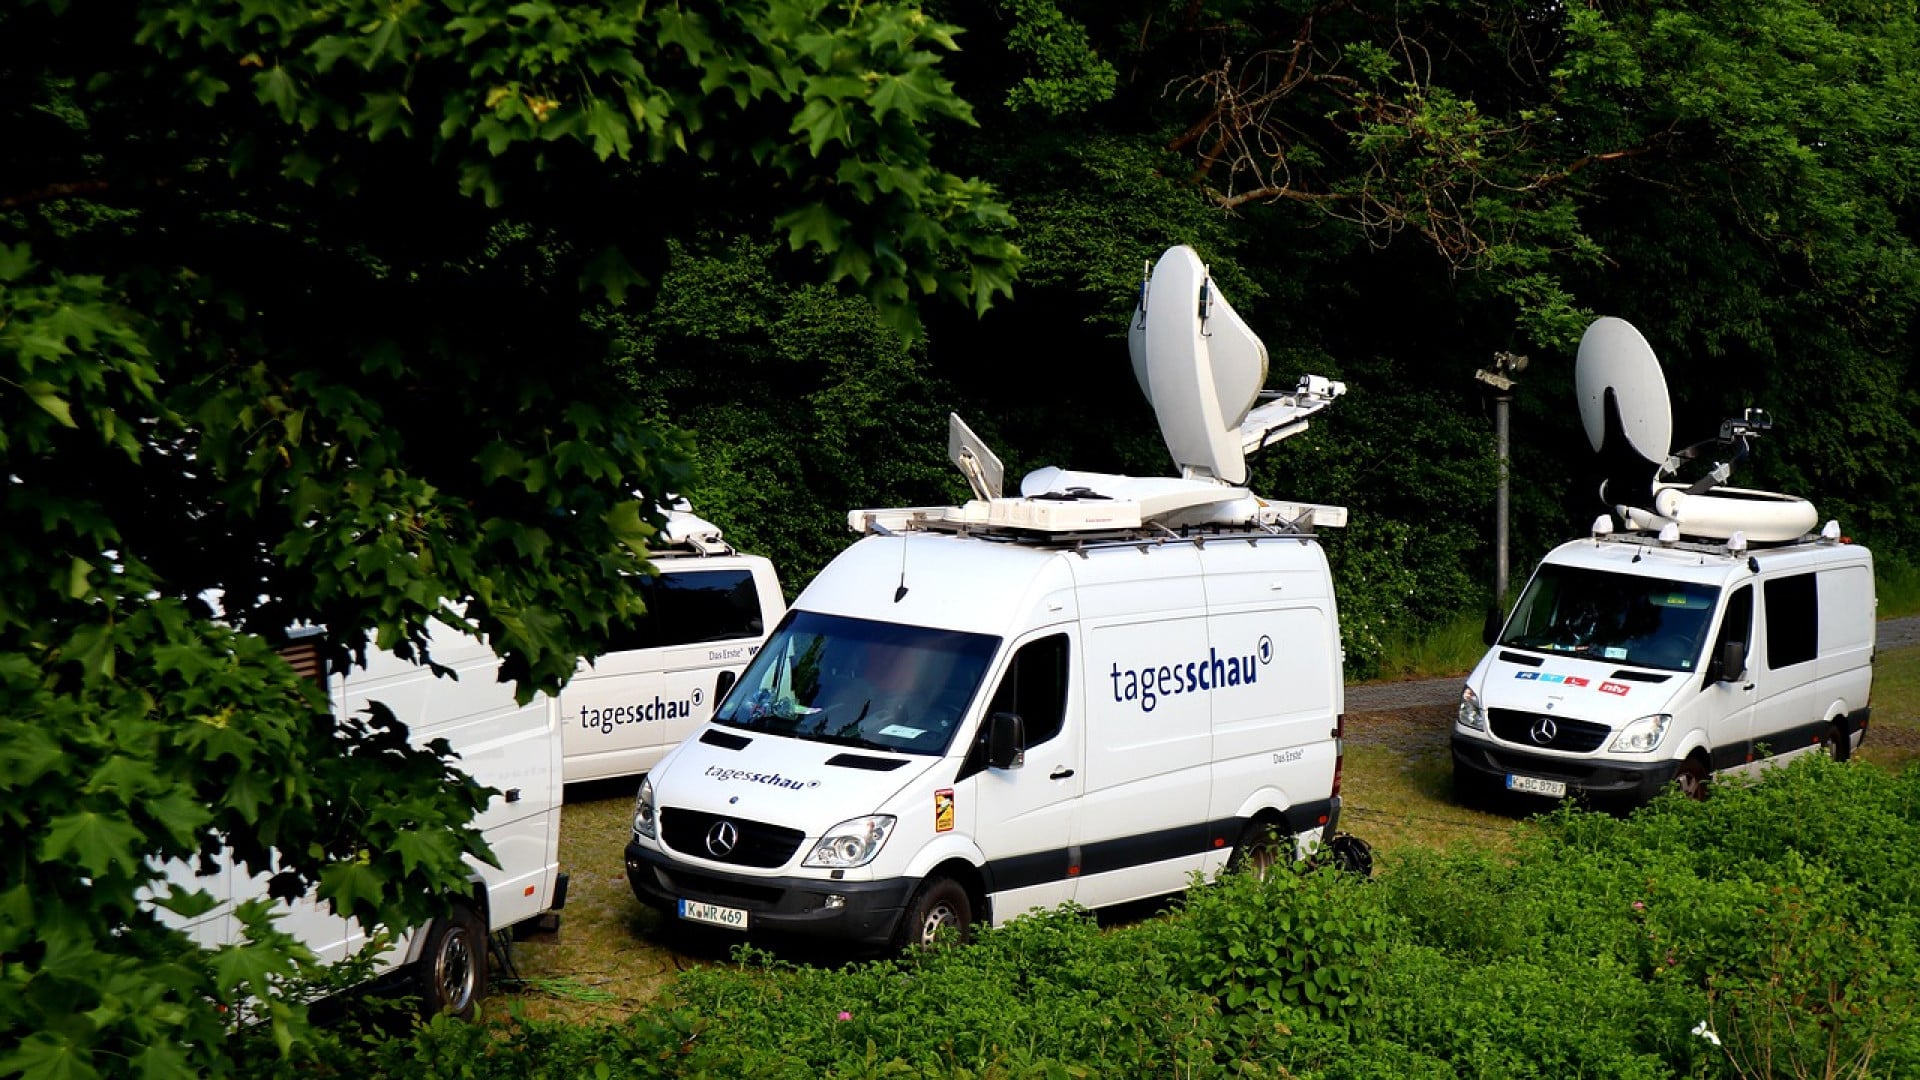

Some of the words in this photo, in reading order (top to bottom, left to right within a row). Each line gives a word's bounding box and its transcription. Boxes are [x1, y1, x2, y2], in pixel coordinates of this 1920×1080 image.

[709, 650, 721, 661] Das
[1110, 647, 1257, 713] tagesschau
[580, 696, 690, 734] tagesschau
[1273, 753, 1285, 764] Das
[704, 763, 804, 790] tagesschau
[688, 902, 696, 917] K
[702, 905, 718, 921] WR
[720, 908, 742, 925] 469
